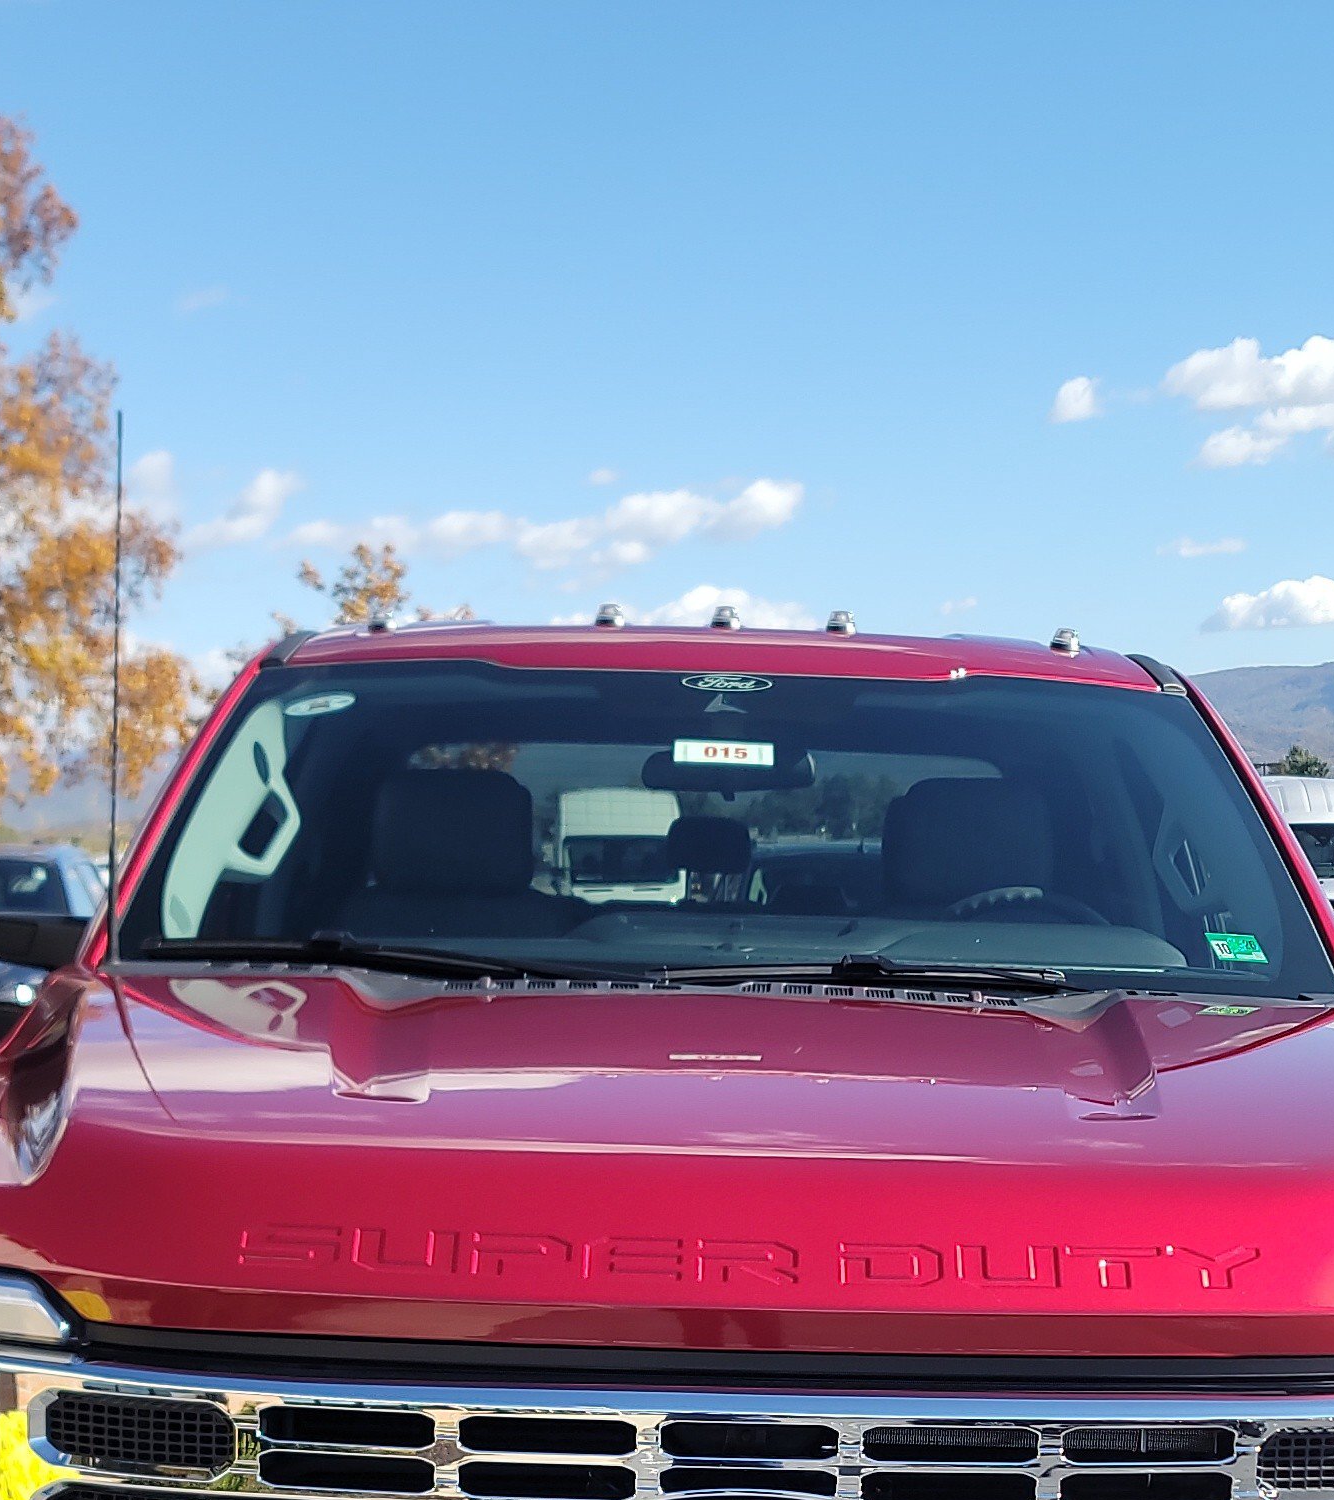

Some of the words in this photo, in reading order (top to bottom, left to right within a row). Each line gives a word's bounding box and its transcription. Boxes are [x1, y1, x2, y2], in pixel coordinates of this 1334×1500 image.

[698, 676, 756, 689] Ford
[704, 746, 748, 759] 015
[238, 1224, 799, 1286] SUPER
[838, 1242, 1261, 1290] DUTY
